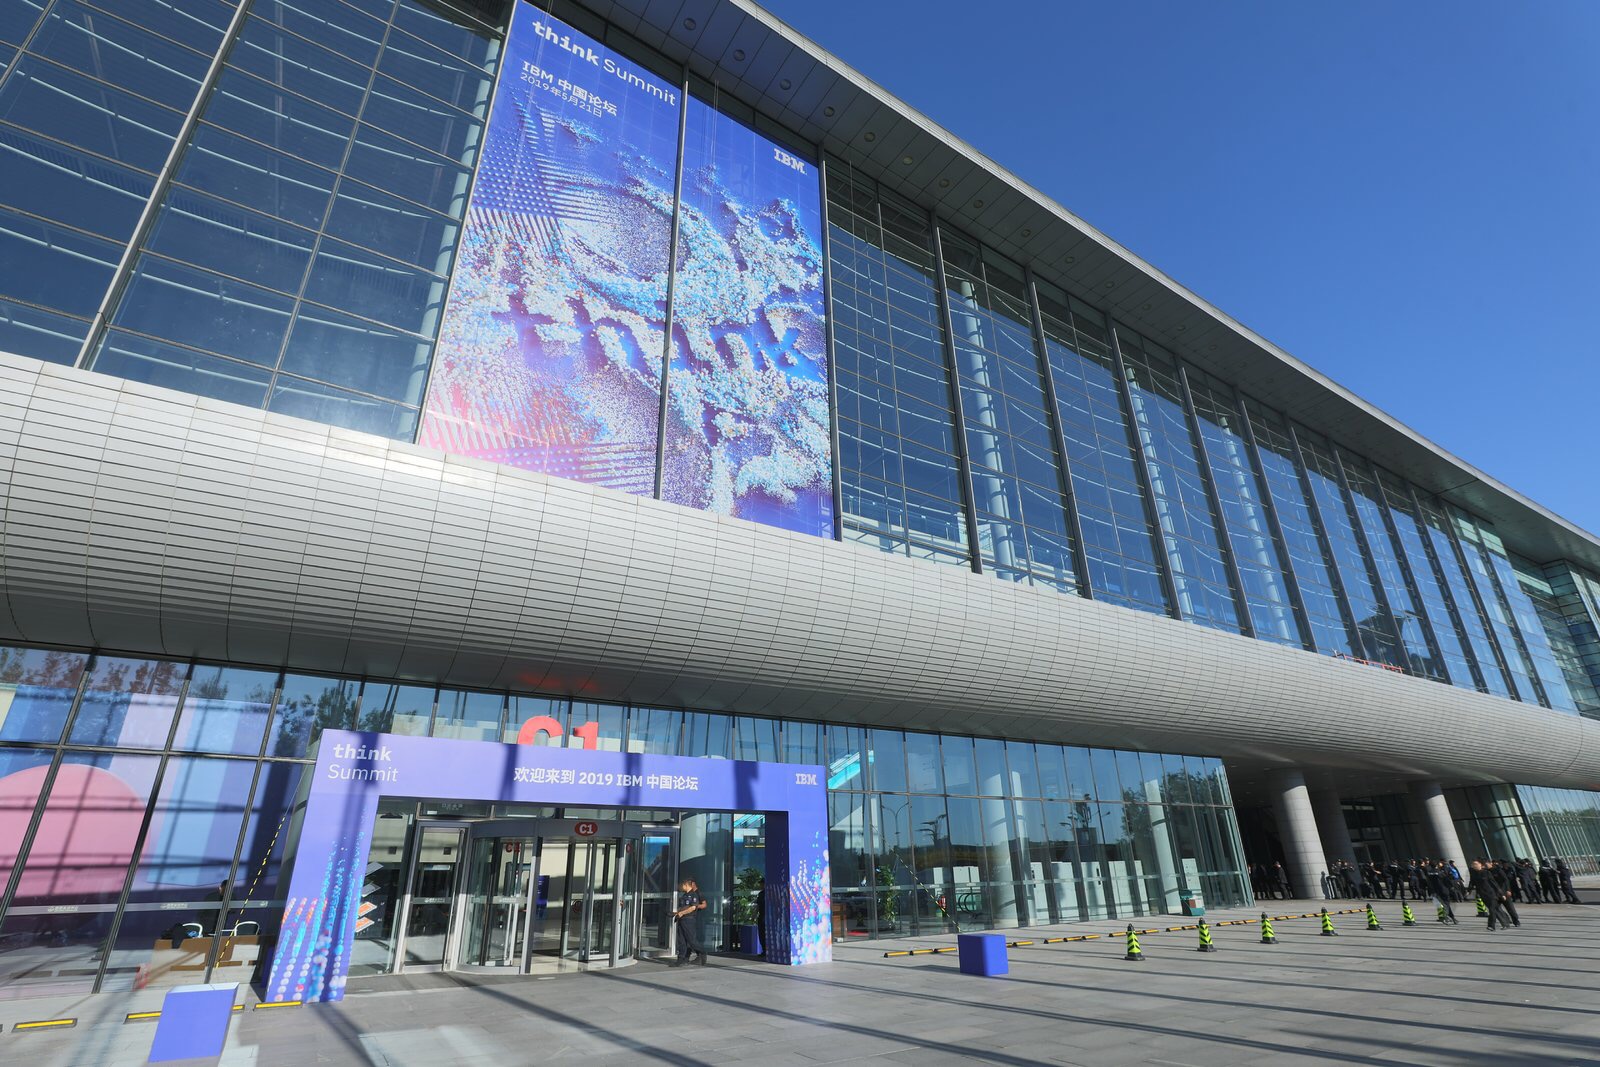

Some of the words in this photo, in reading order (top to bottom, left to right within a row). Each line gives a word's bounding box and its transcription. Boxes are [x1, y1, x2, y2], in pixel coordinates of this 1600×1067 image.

[532, 20, 599, 66] think
[603, 58, 677, 106] Summit
[520, 72, 602, 119] 2019年5月21日
[522, 60, 554, 83] IBM
[557, 79, 617, 116] 中国论坛
[774, 148, 807, 175] IBM
[333, 743, 392, 762] think
[327, 764, 399, 782] Summit
[513, 767, 575, 785] 欢迎来到
[578, 771, 613, 786] 2019
[616, 774, 643, 787] IBM
[646, 774, 699, 791] 中国论坛
[795, 773, 819, 786] IBM
[579, 823, 594, 834] C1
